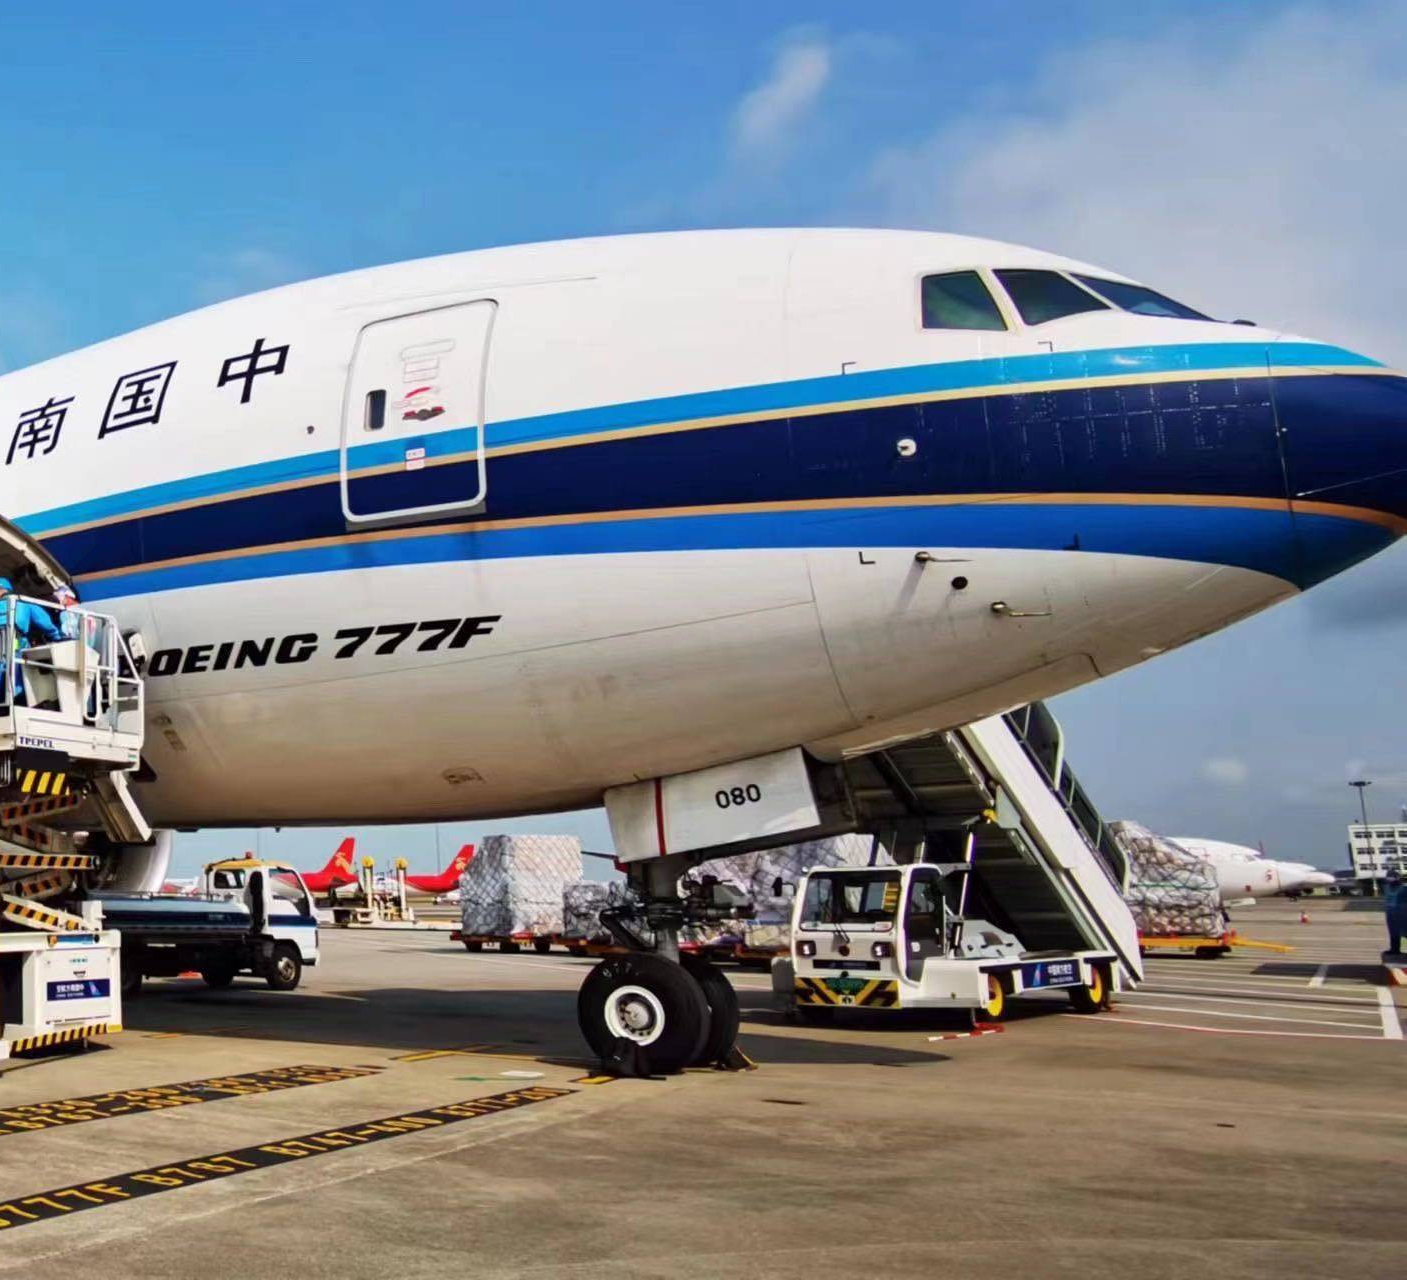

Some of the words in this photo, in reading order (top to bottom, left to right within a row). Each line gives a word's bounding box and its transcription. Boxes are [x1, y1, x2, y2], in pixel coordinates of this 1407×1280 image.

[119, 632, 319, 677] OEING
[334, 615, 502, 660] 777F
[715, 784, 761, 809] 080
